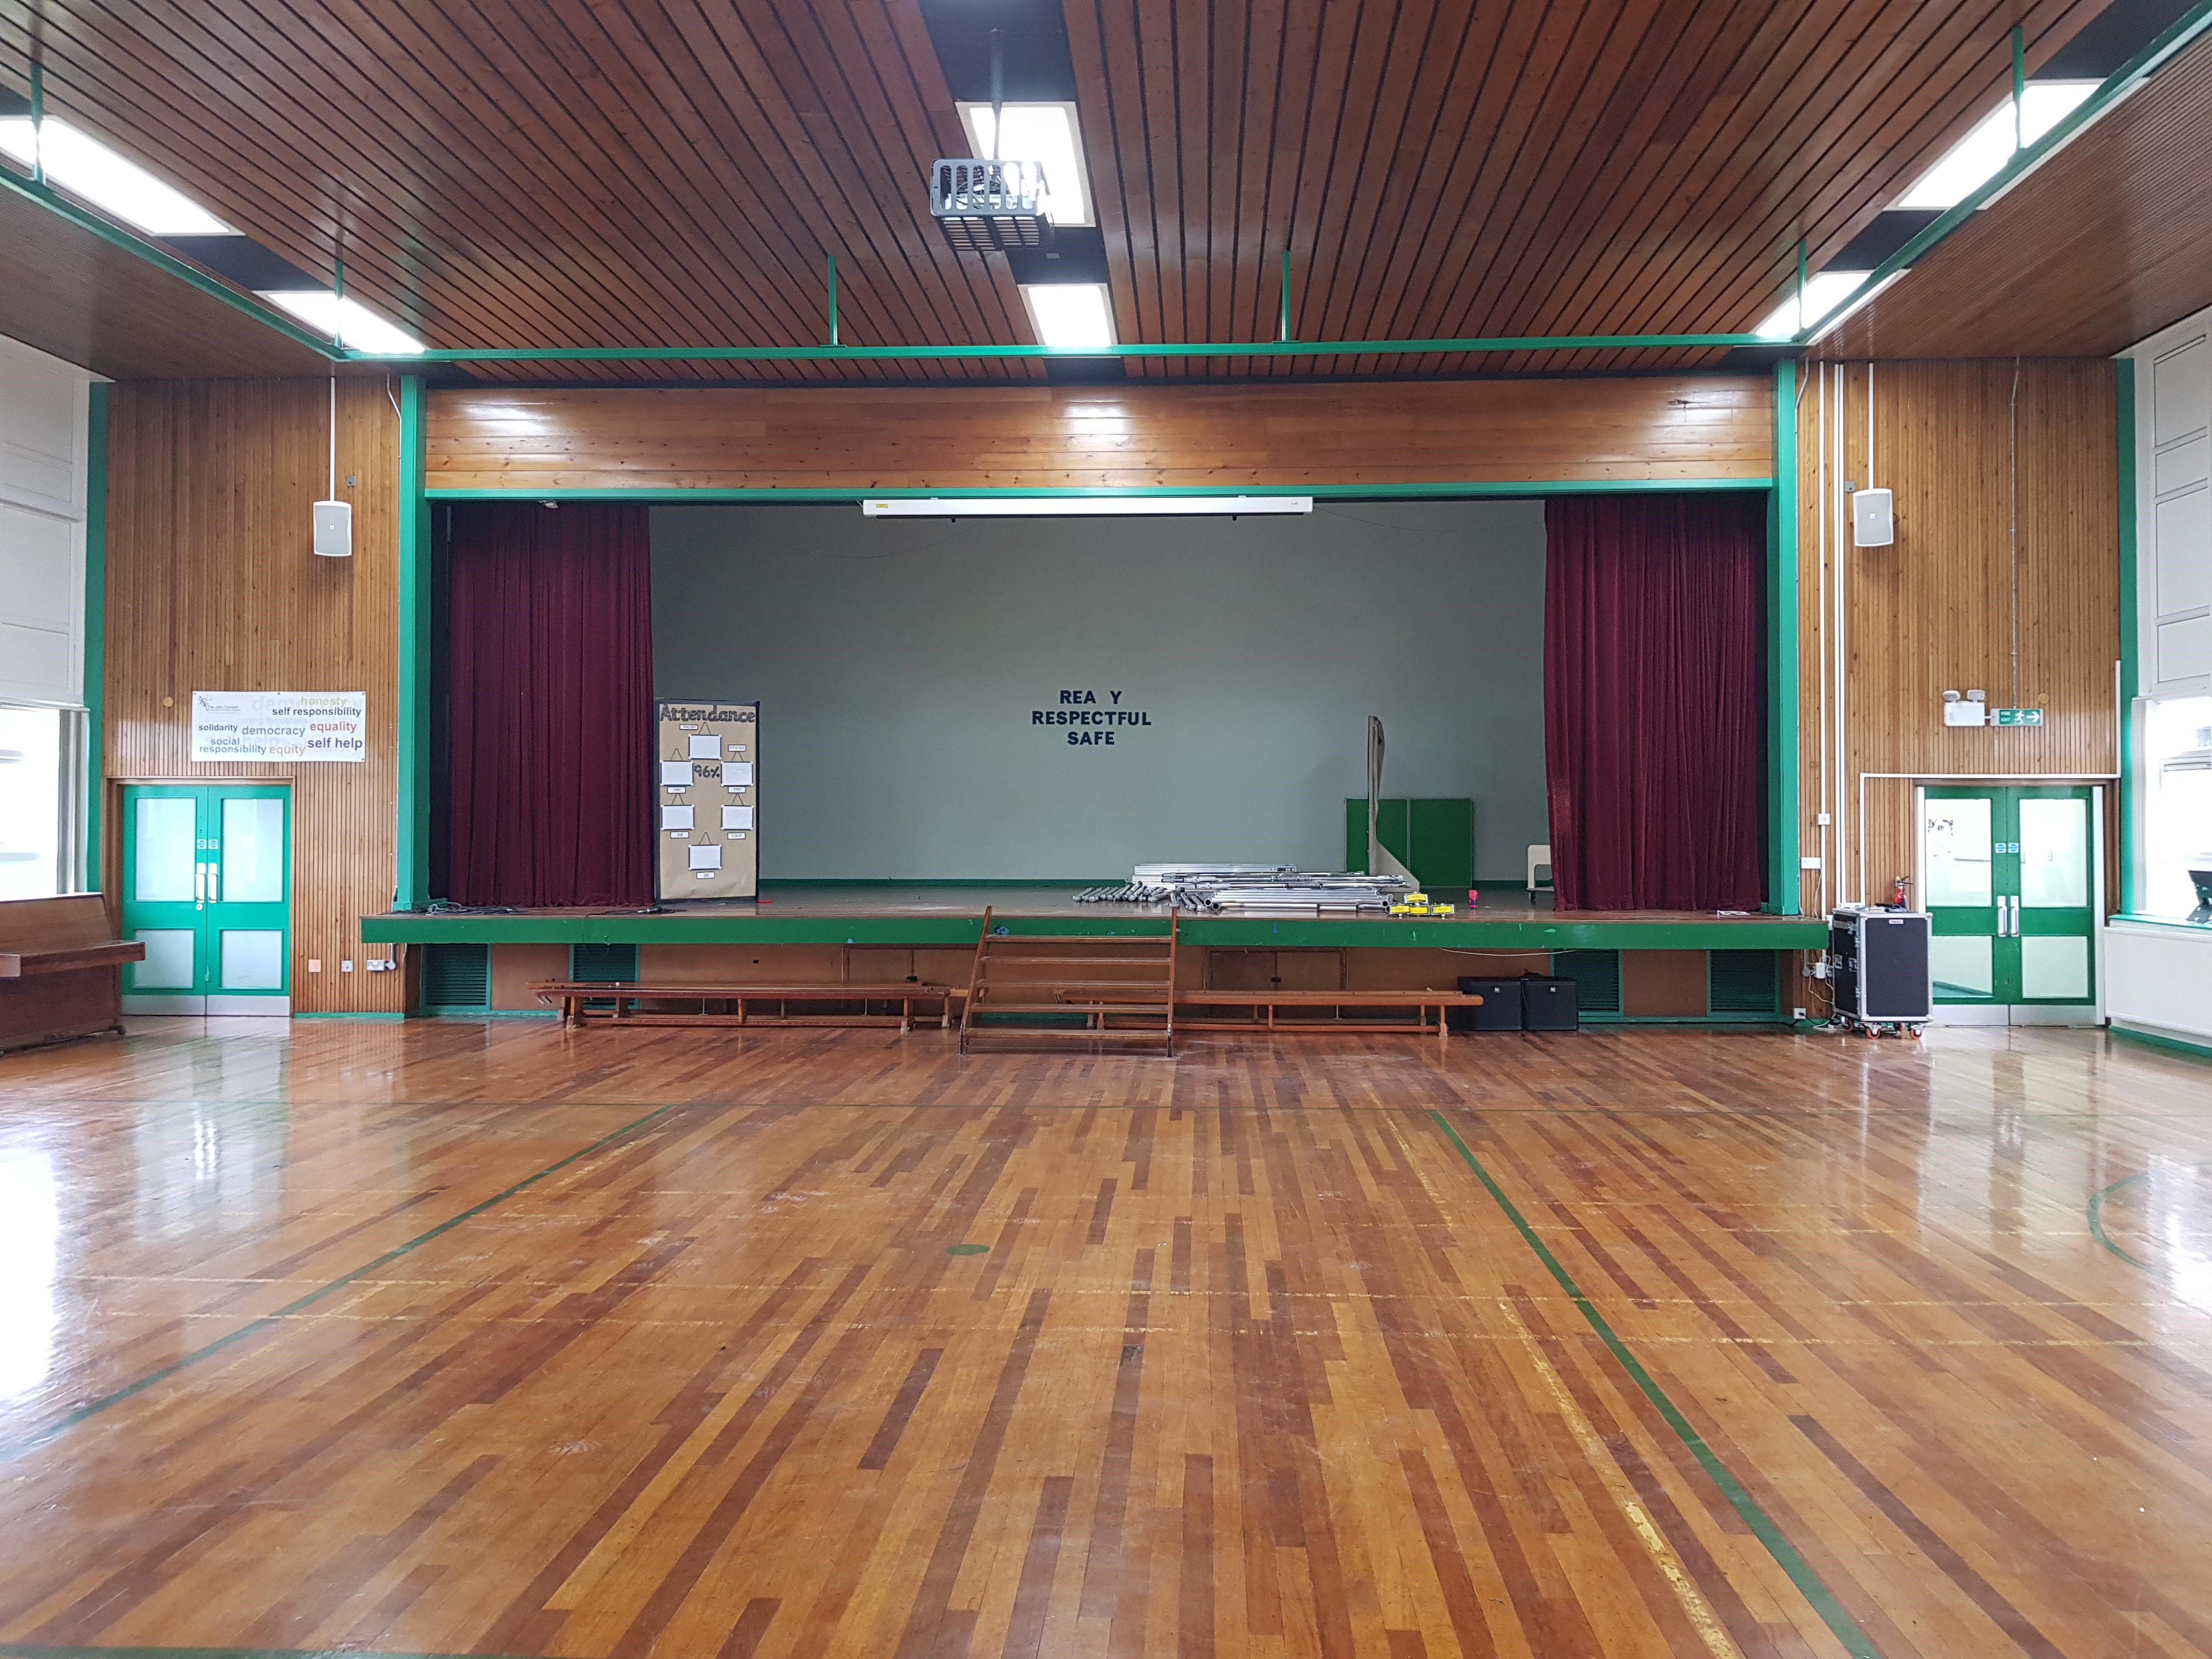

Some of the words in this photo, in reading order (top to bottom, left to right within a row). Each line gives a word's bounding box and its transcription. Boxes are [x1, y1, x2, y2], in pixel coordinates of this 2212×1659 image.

[301, 696, 347, 708] honesty
[272, 707, 290, 715] self
[293, 707, 362, 718] responsibility
[660, 704, 755, 723] Attendance
[1032, 710, 1152, 726] RESPECTFUL
[198, 724, 238, 732] solidarity
[242, 726, 306, 737] democracy
[309, 721, 357, 733] equality
[210, 737, 240, 746] social
[307, 737, 331, 748] self
[335, 737, 363, 751] help
[1067, 731, 1115, 745] SAFE
[199, 745, 267, 755] responsibility
[269, 744, 306, 756] equity
[693, 764, 720, 778] 96%
